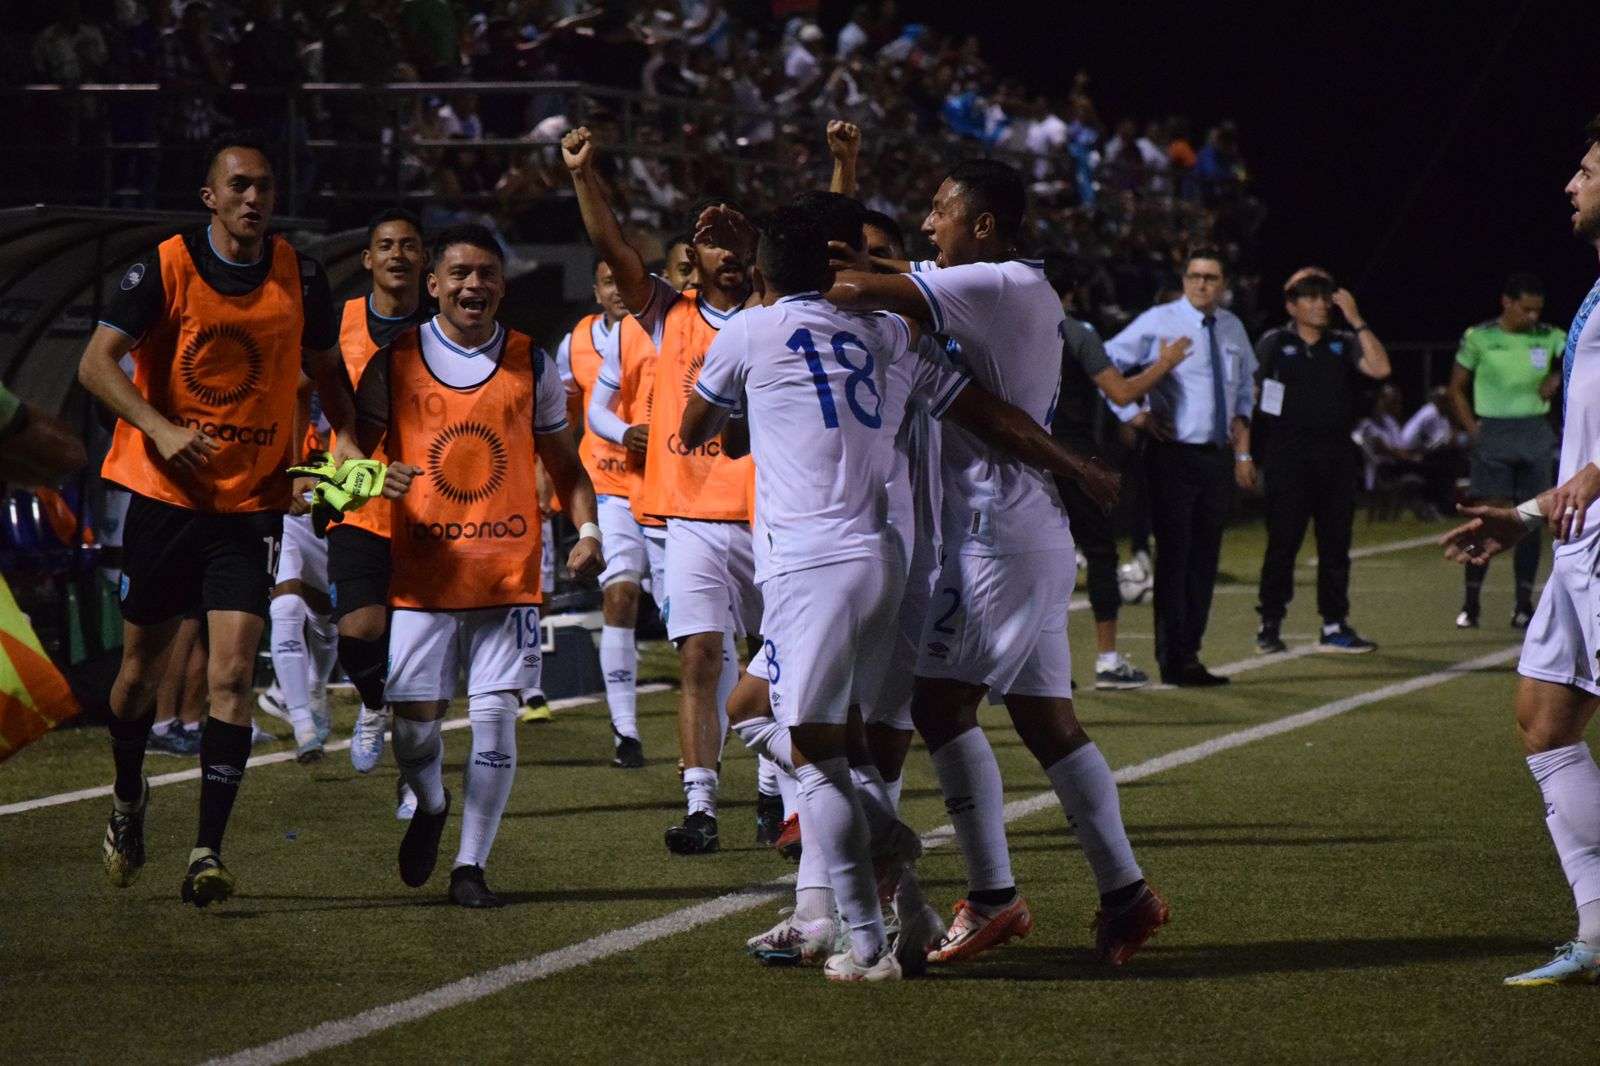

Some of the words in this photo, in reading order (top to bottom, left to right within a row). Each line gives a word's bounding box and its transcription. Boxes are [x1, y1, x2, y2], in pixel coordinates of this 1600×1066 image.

[785, 328, 882, 429] 18
[511, 609, 538, 650] 19
[934, 587, 961, 634] 2
